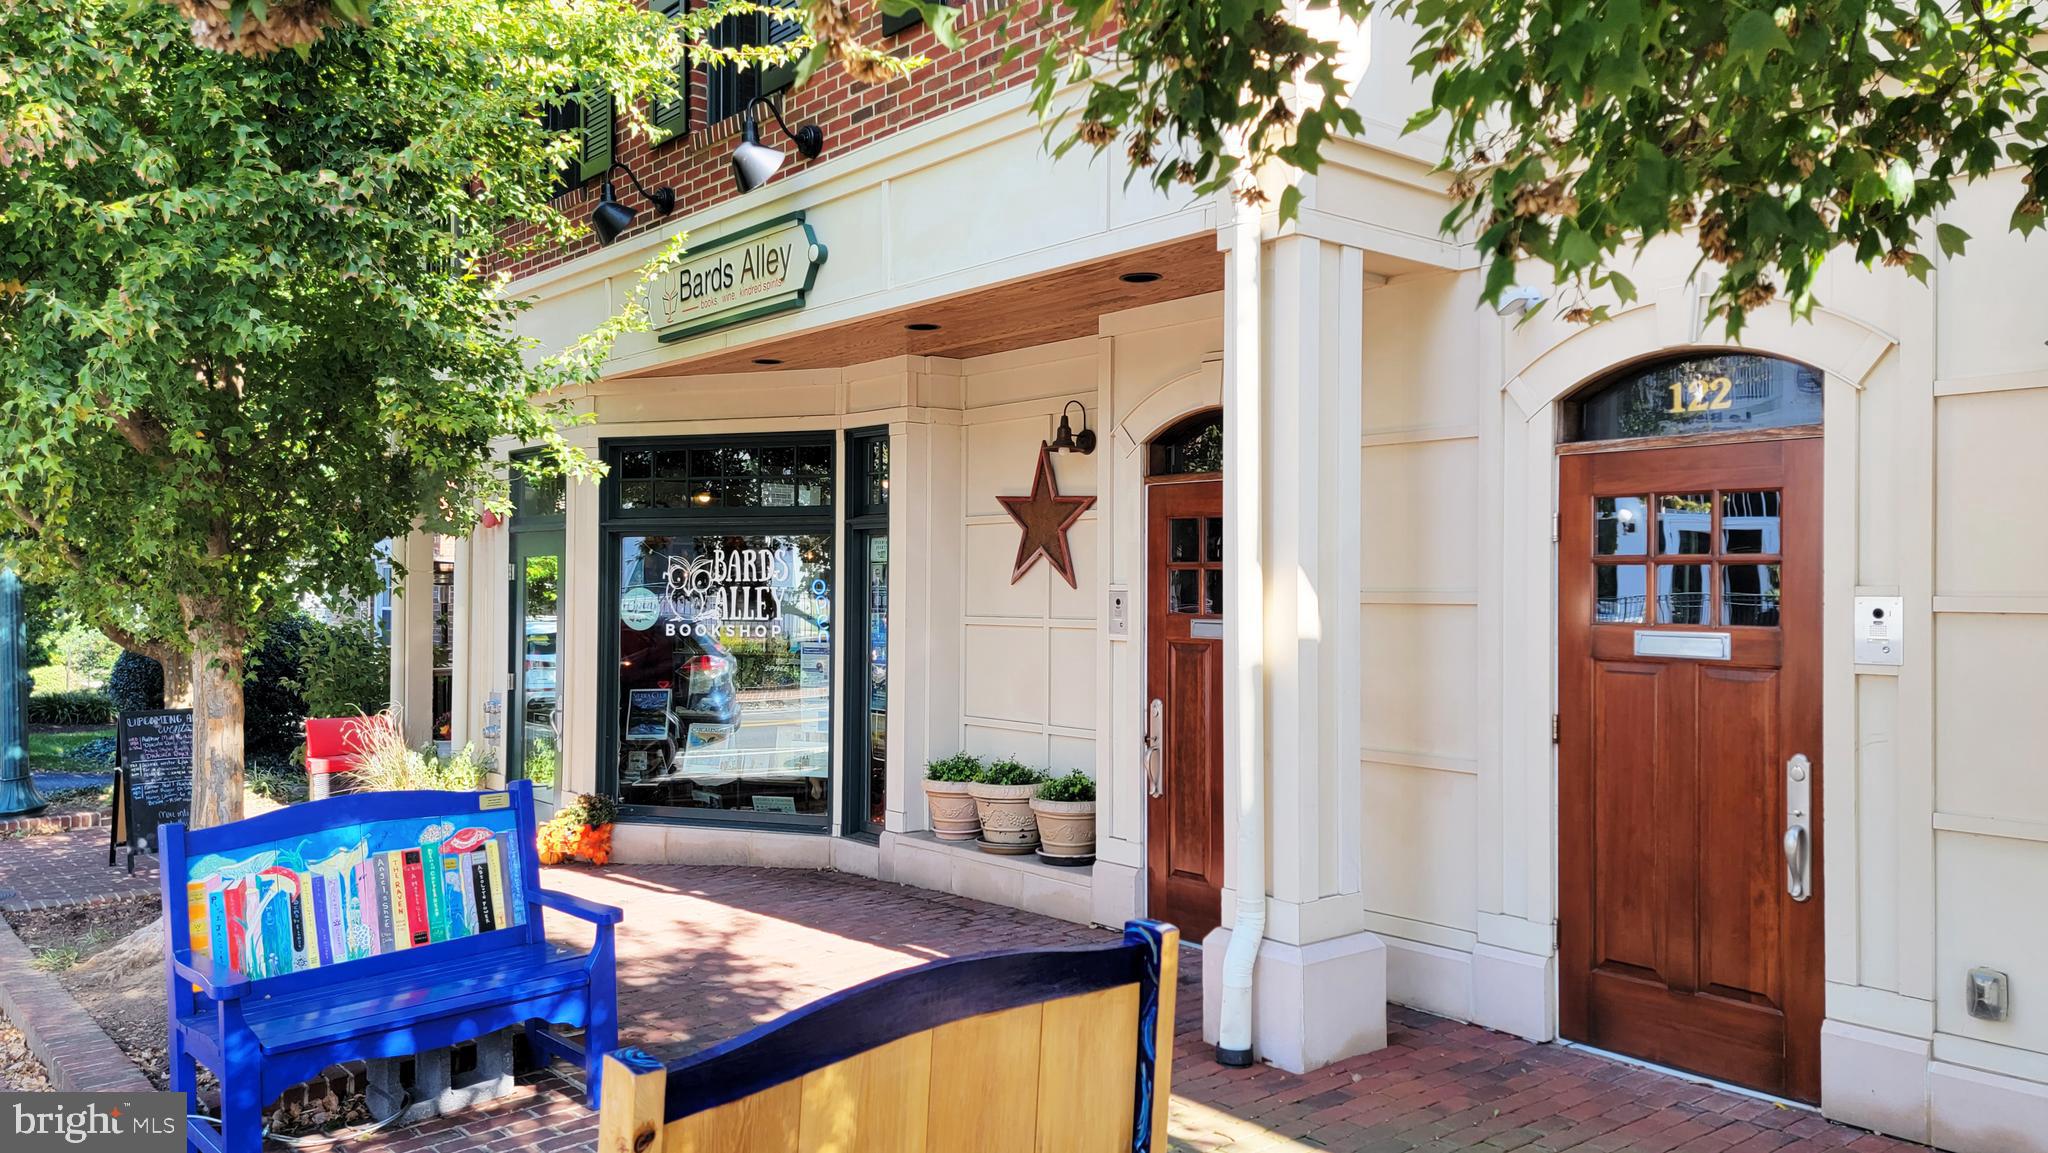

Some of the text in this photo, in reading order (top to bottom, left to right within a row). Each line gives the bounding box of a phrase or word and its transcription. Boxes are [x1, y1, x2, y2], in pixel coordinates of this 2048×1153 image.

[679, 243, 792, 302] Bards Alley
[739, 283, 762, 297] kindred
[1668, 376, 1732, 414] 122
[713, 549, 788, 583] BARDS
[715, 586, 787, 622] ALLEY
[665, 624, 782, 637] BOOKSHOP
[127, 714, 183, 728] UPCOMING
[395, 882, 404, 915] RAVEN
